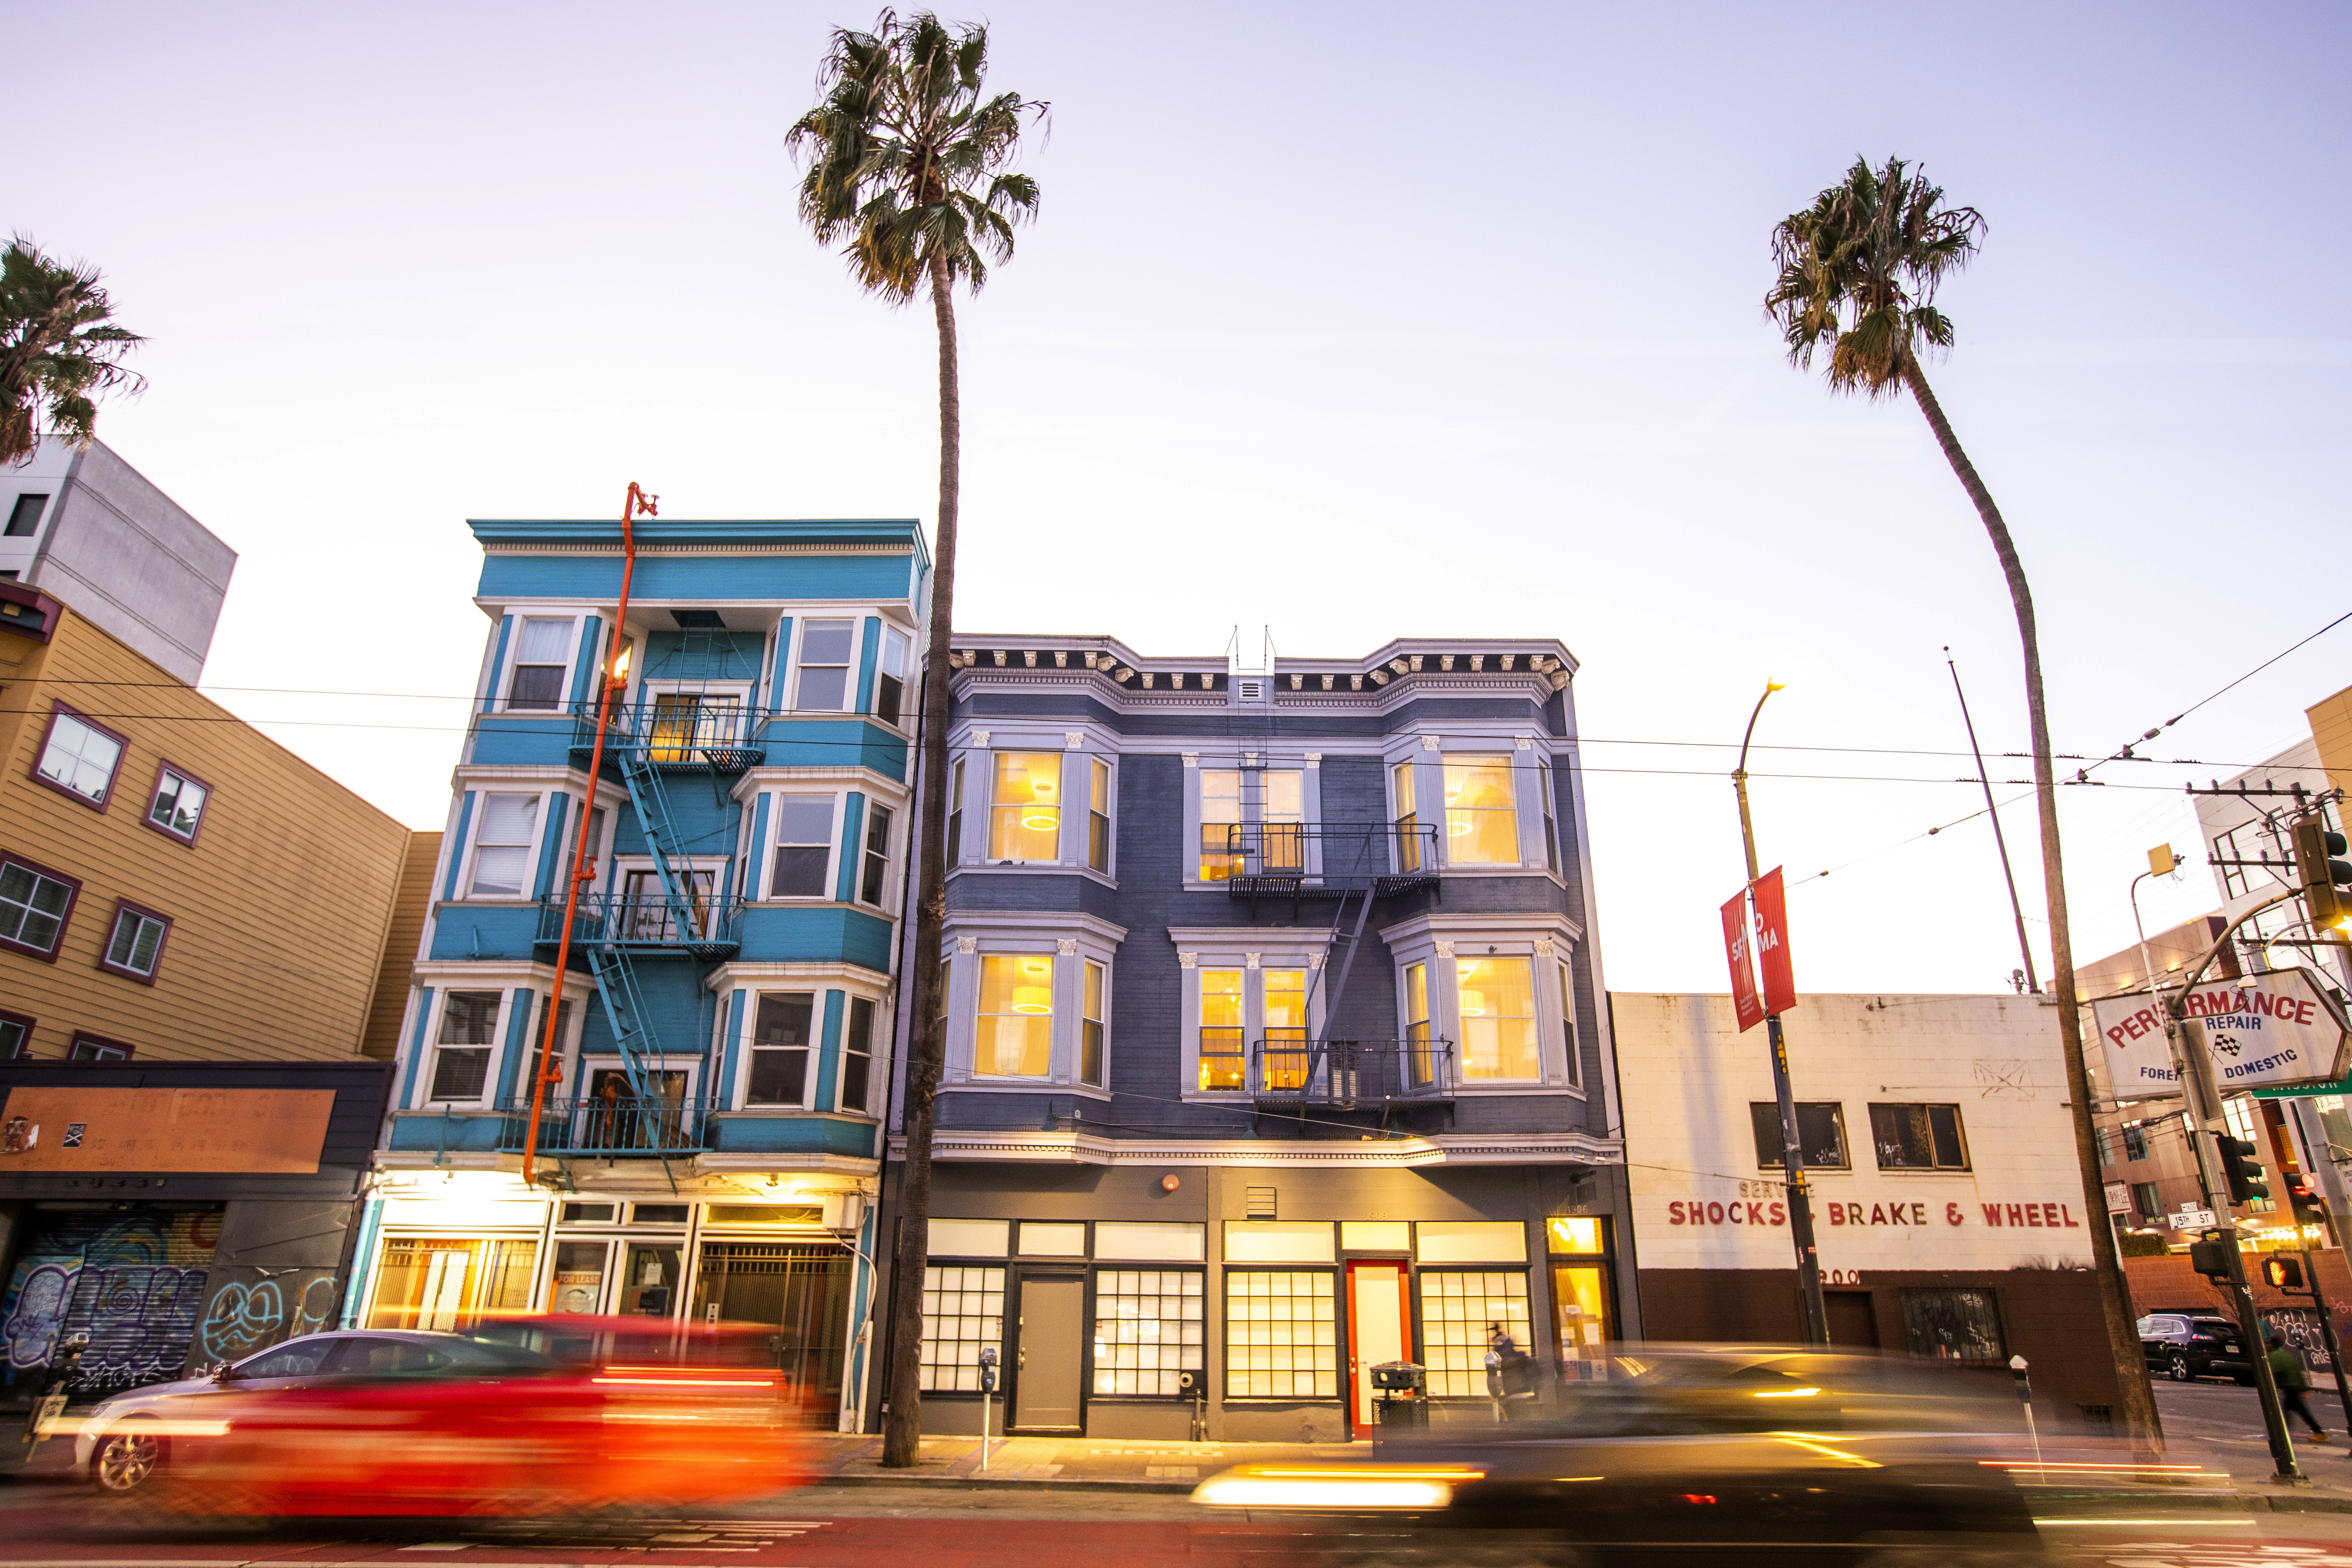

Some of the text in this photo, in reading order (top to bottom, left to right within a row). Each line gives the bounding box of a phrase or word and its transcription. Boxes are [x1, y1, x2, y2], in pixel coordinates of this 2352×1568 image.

[2106, 990, 2316, 1049] PERFRMANCE
[2205, 1016, 2261, 1030] REPAIR
[2140, 1049, 2298, 1081] FOREI DOMESTIC
[1365, 1212, 1388, 1220] 1908
[1669, 1201, 2079, 1227] SHOCKS BRAKE & WHEEL
[2175, 1213, 2209, 1226] 15TH ST
[558, 1275, 600, 1283] FOR LEASE
